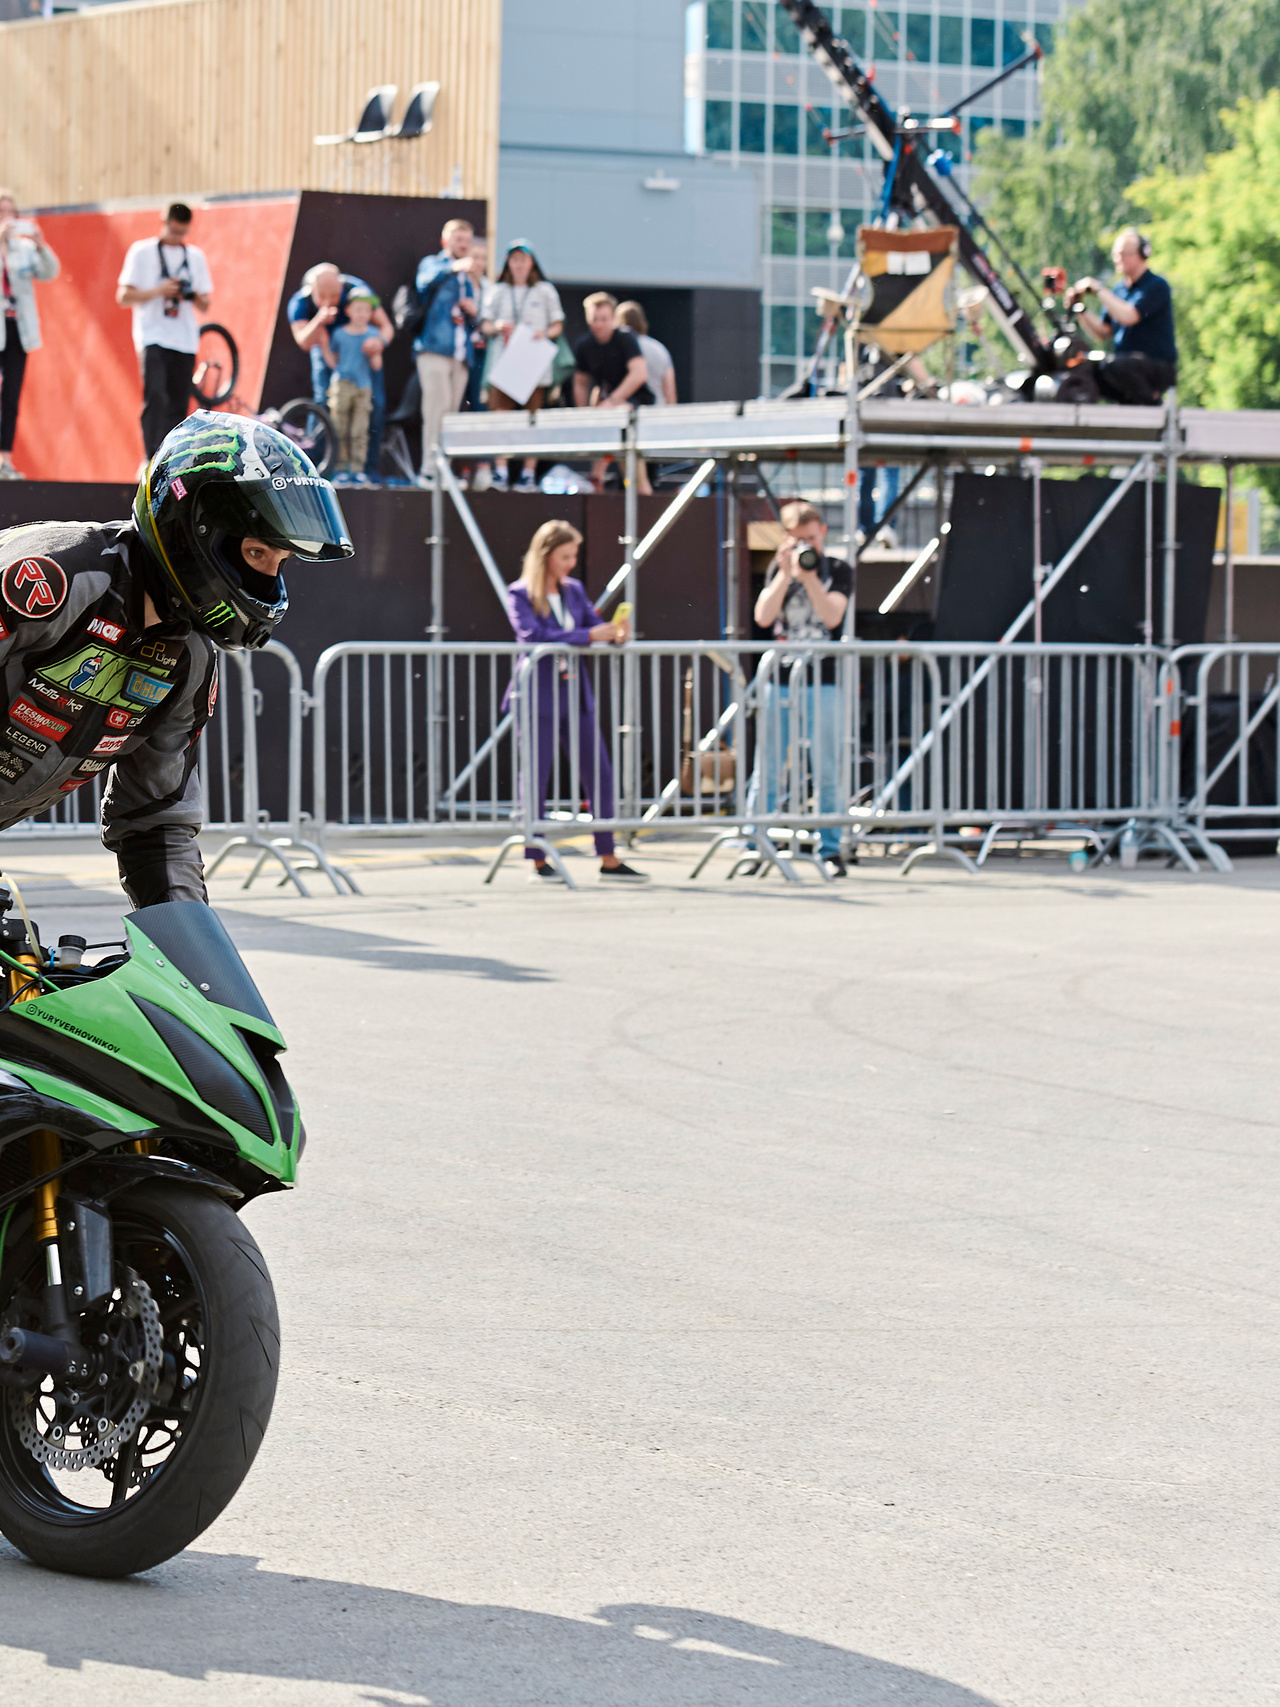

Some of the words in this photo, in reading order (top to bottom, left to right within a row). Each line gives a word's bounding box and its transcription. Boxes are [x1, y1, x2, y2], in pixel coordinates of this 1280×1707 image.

[16, 702, 67, 733] DESMOCLUB
[5, 726, 47, 753] LEGEND
[37, 1009, 121, 1054] YURYVERHOVNIKOV
